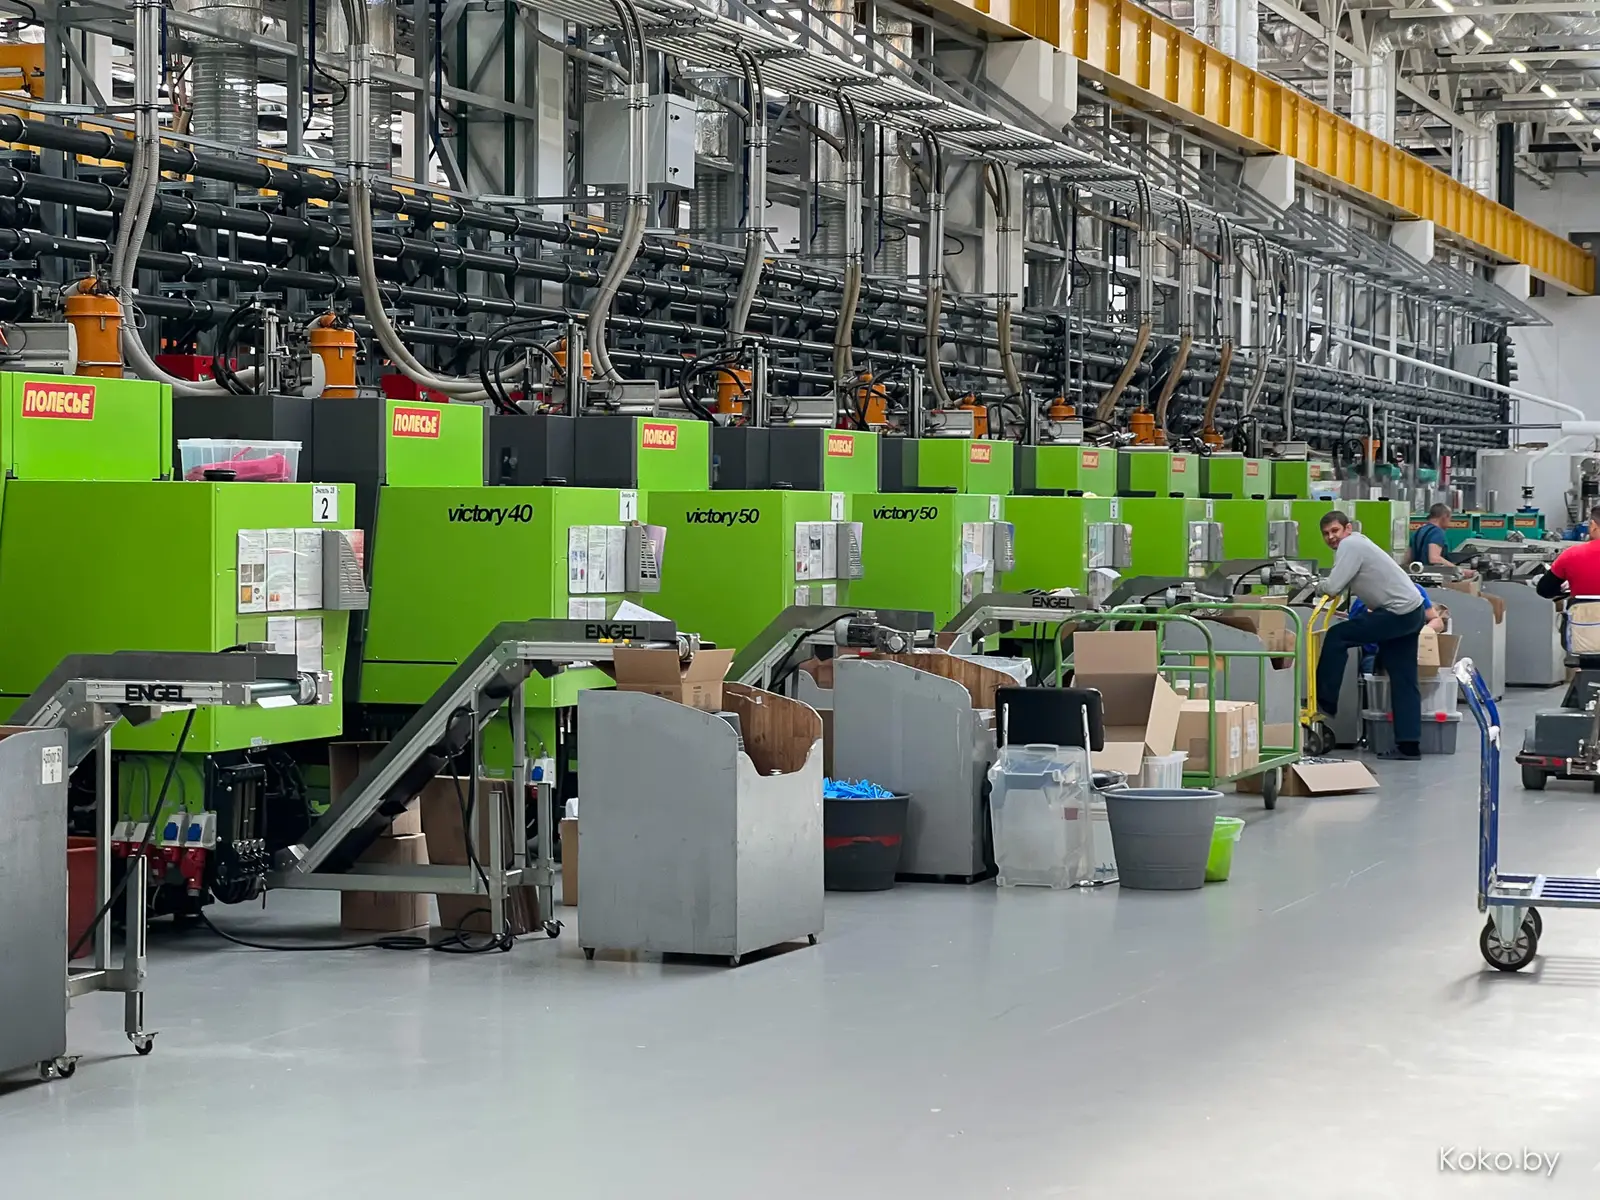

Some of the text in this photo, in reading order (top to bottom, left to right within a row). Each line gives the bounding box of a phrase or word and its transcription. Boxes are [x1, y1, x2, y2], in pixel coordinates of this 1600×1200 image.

[25, 390, 91, 414] ПОЛЕСЬЕ
[394, 413, 438, 434] ПОЛЕСЬЕ
[643, 428, 676, 446] ПОЛЕСЬЕ
[321, 497, 329, 520] 2
[448, 503, 533, 526] victory 40
[625, 500, 630, 520] 1
[686, 507, 760, 527] victory 50
[873, 505, 938, 523] victory 50
[1032, 596, 1076, 609] ENGEL
[585, 624, 646, 640] ENGEL
[125, 684, 193, 703] ENGEL
